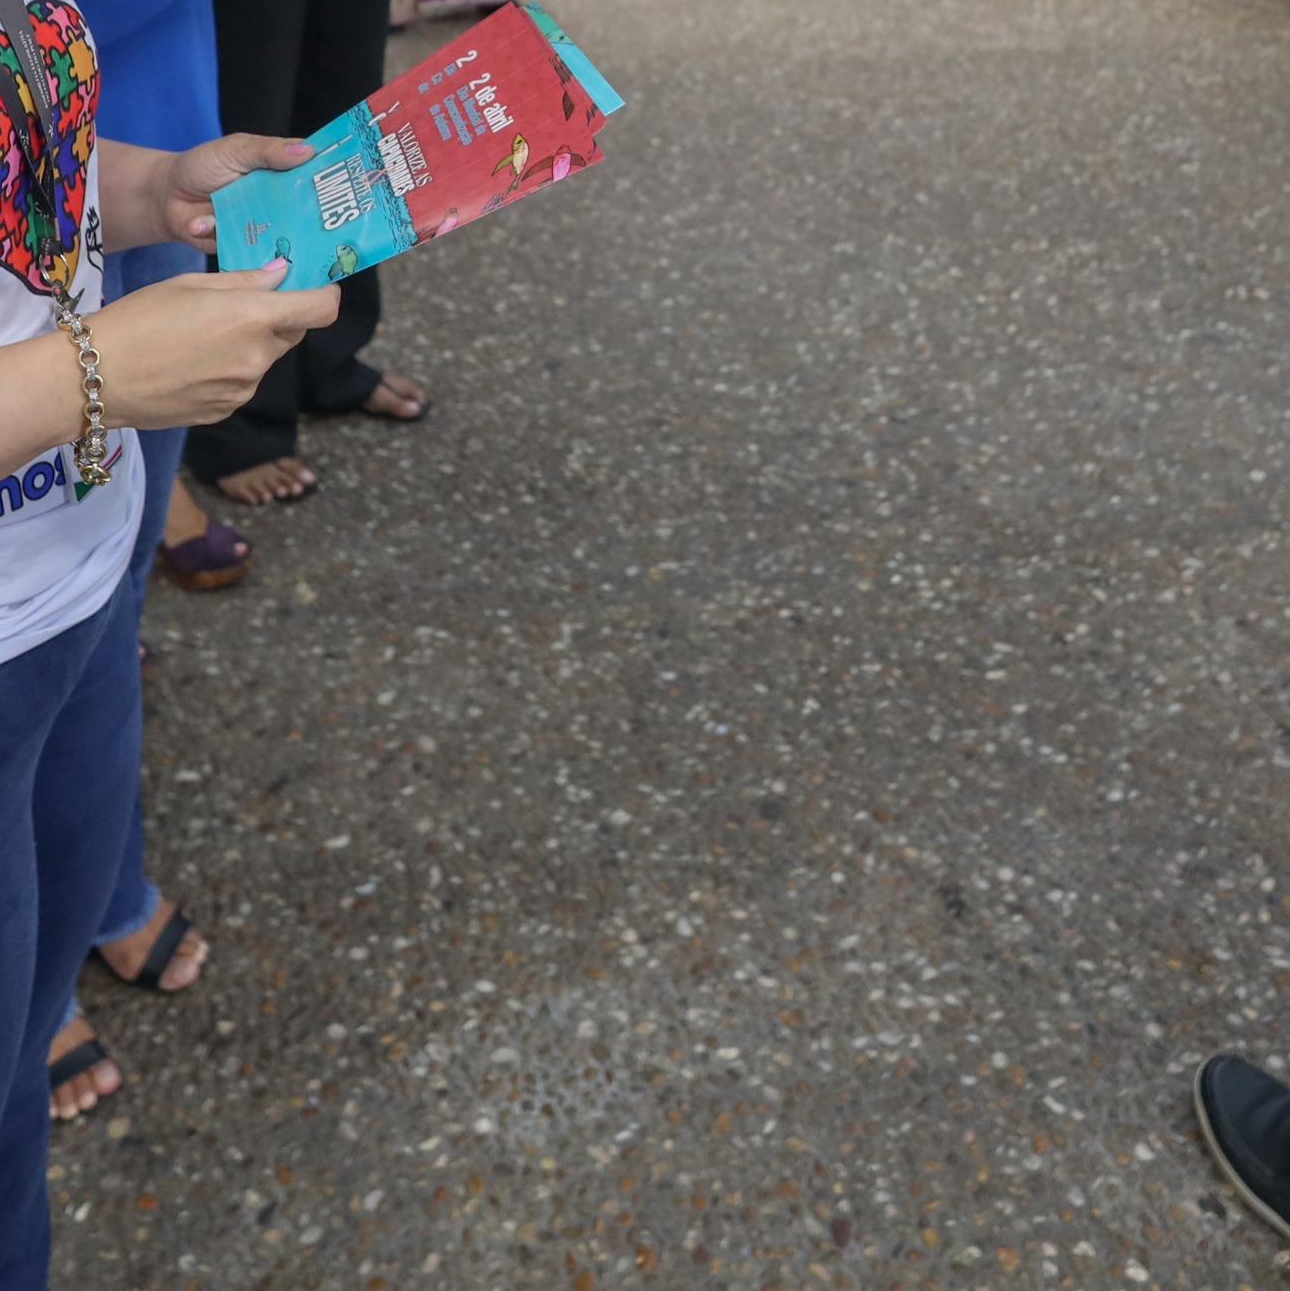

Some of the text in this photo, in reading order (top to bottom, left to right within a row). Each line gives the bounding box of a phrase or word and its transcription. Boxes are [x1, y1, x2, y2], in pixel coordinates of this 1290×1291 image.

[469, 73, 514, 133] 2 de abril
[345, 152, 372, 200] RESPEITE
[359, 198, 376, 213] OS
[377, 133, 415, 197] CAPACIDADES
[397, 122, 432, 187] VALORIZE AS
[313, 160, 360, 230] LIMITES
